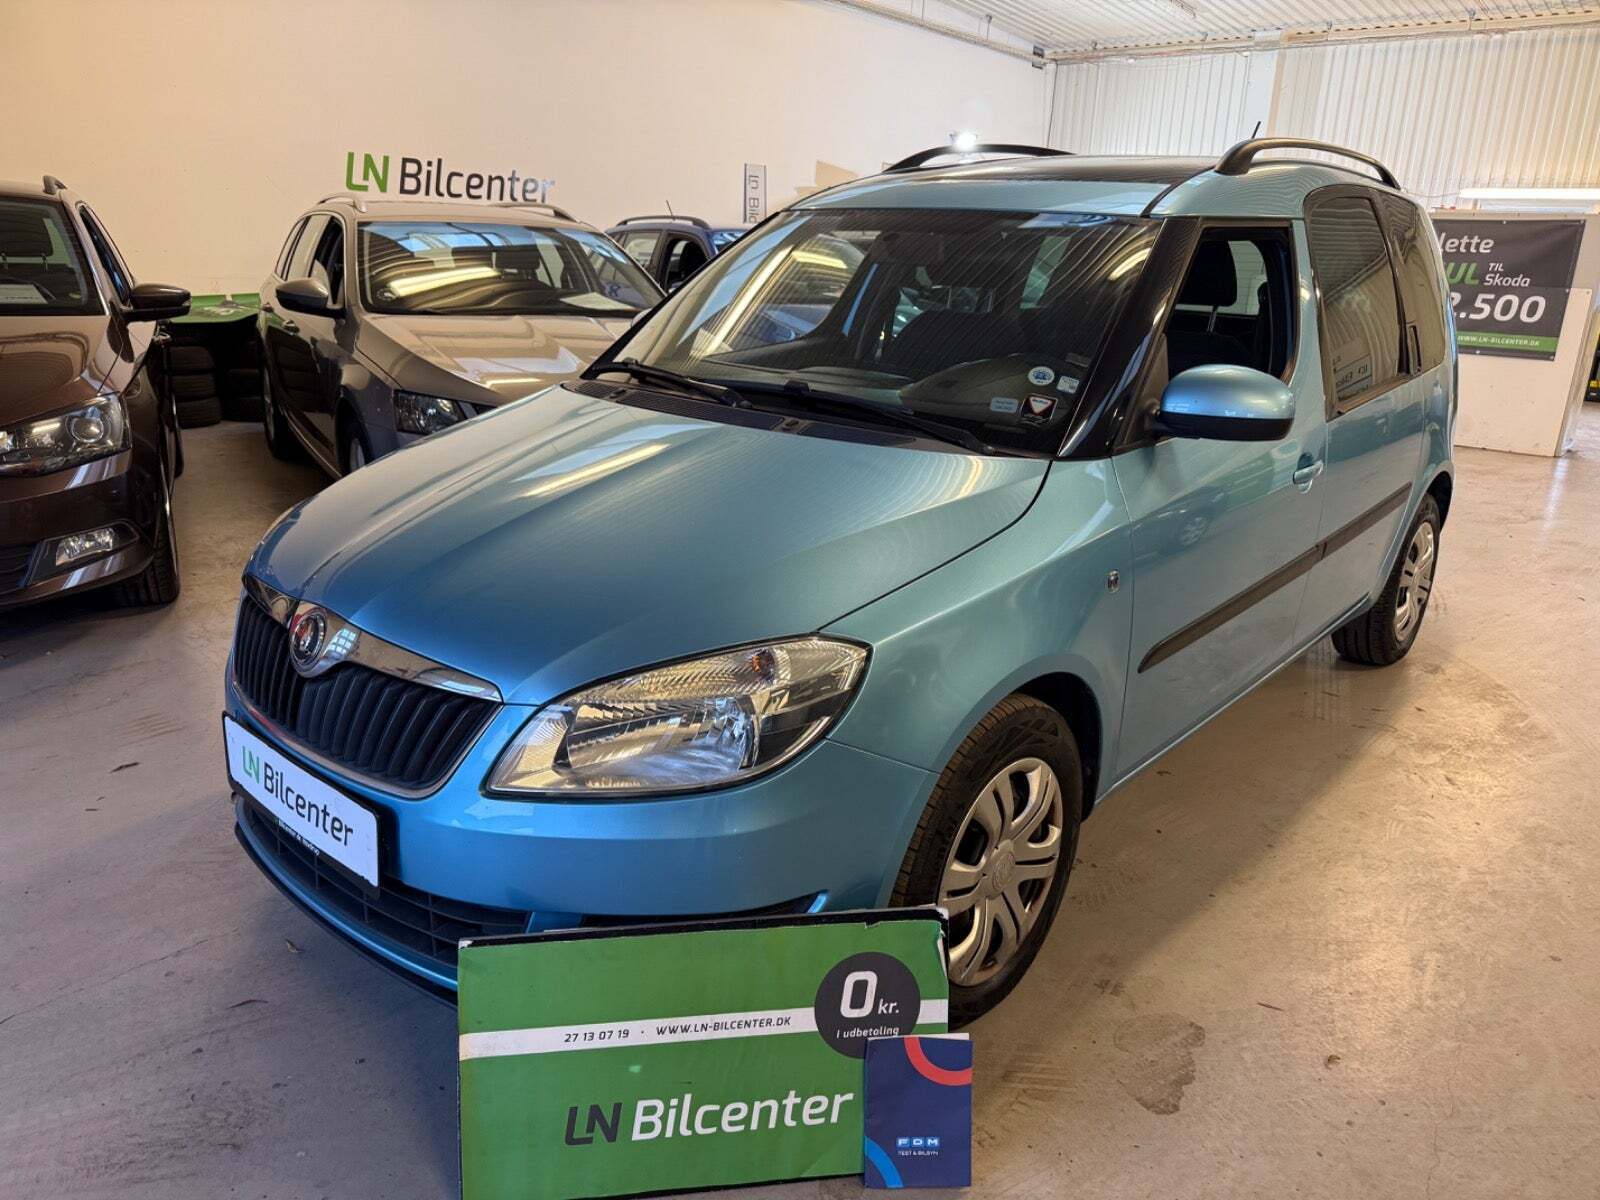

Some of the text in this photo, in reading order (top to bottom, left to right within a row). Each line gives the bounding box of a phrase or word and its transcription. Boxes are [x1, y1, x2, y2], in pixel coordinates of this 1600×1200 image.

[346, 152, 555, 203] LN Bilcenter
[1484, 274, 1530, 287] Skoda
[242, 746, 260, 784] LN
[264, 762, 354, 846] Bilcenter
[878, 998, 900, 1015] kr.
[564, 1016, 791, 1043] 27 13 07 19 WWW.LN-BILCENTER.DK
[843, 1024, 900, 1038] udbetaling
[565, 1090, 854, 1146] LN Bilcenter
[898, 1137, 939, 1147] FDM
